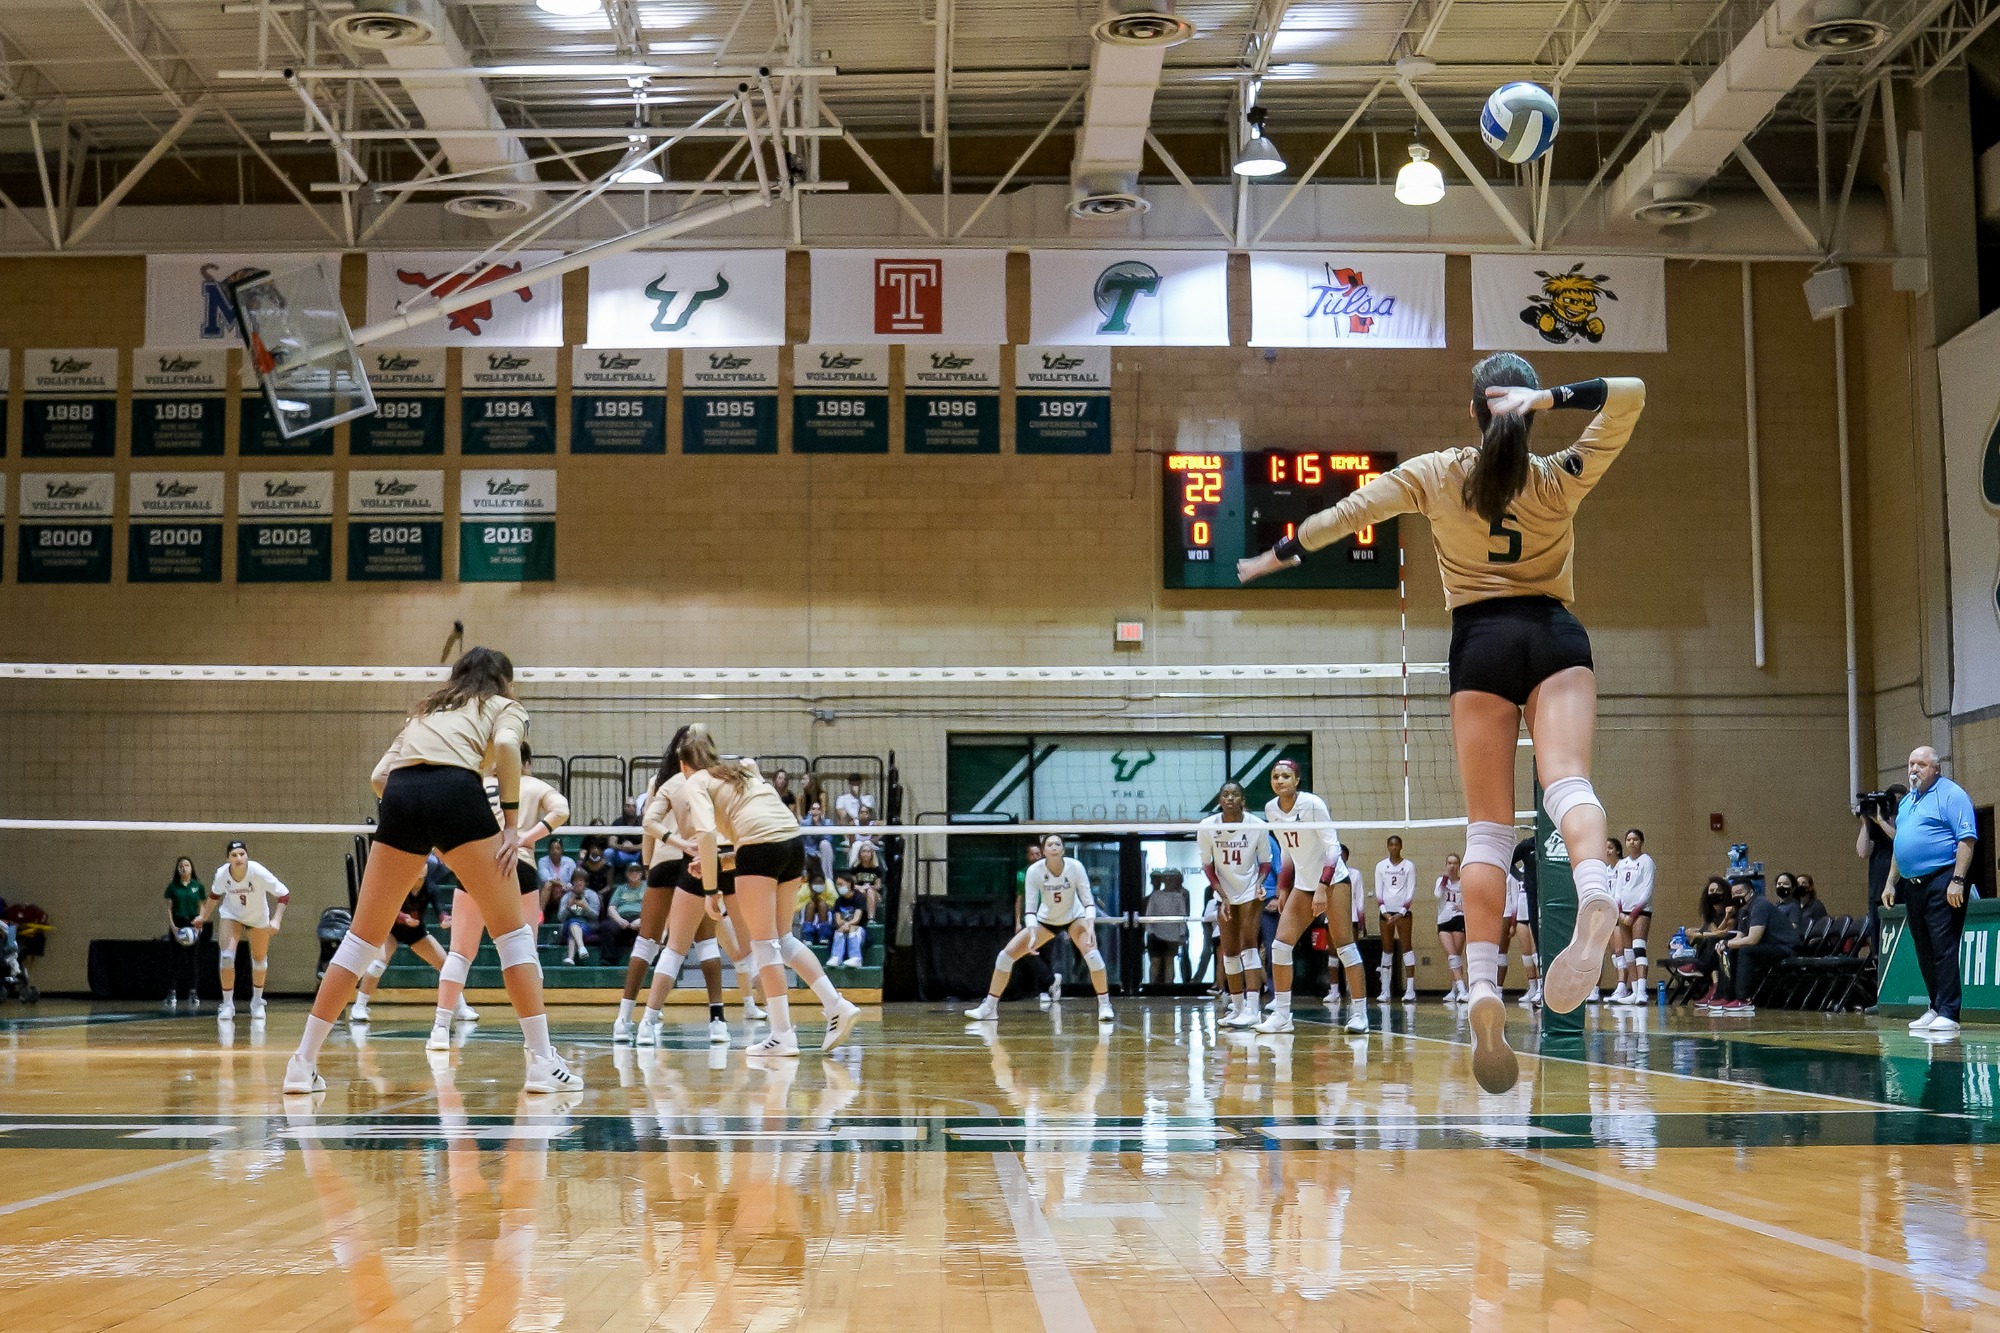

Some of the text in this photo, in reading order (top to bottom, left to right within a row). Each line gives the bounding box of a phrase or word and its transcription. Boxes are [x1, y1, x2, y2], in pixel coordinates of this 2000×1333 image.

[1304, 285, 1397, 318] Tulsa
[36, 376, 105, 386] VOLLEYBALL
[144, 374, 214, 385] VOLLEYBALL
[474, 373, 545, 383] VOLLEYBALL
[584, 373, 655, 382] VOLLEYBALL
[695, 373, 767, 382] VOLLEYBALL
[806, 372, 877, 382] VOLLEYBALL
[917, 373, 989, 382] VOLLEYBALL
[1028, 373, 1099, 382] VOLLEYBALL
[46, 404, 94, 421] 1988
[155, 403, 203, 420] 1989
[374, 402, 422, 418] 1993
[484, 401, 534, 418] 1994
[595, 401, 643, 417] 1995
[706, 401, 755, 417] 1995
[816, 401, 865, 417] 1996
[928, 401, 977, 417] 1996
[1039, 401, 1087, 417] 1997
[1271, 454, 1321, 484] 1:15
[1330, 456, 1370, 470] TEMPLE
[1186, 472, 1221, 502] 22
[32, 501, 102, 511] VOLLEYBALL
[142, 499, 212, 510] VOLLEYBALL
[250, 499, 321, 510] VOLLEYBALL
[360, 498, 431, 508] VOLLEYBALL
[473, 498, 544, 508] VOLLEYBALL
[39, 529, 92, 546] 2000
[149, 529, 202, 546] 2000
[258, 528, 312, 546] 2002
[368, 527, 422, 544] 2002
[484, 527, 532, 544] 2018
[1194, 522, 1208, 544] 0
[1488, 514, 1522, 562] 5
[1111, 789, 1144, 798] THE
[1215, 840, 1249, 848] TEMPLE
[1283, 831, 1299, 848] 17
[1223, 850, 1242, 865] 14
[1391, 876, 1397, 886] 2
[1054, 892, 1061, 903] 5
[1958, 930, 1988, 986] TH
